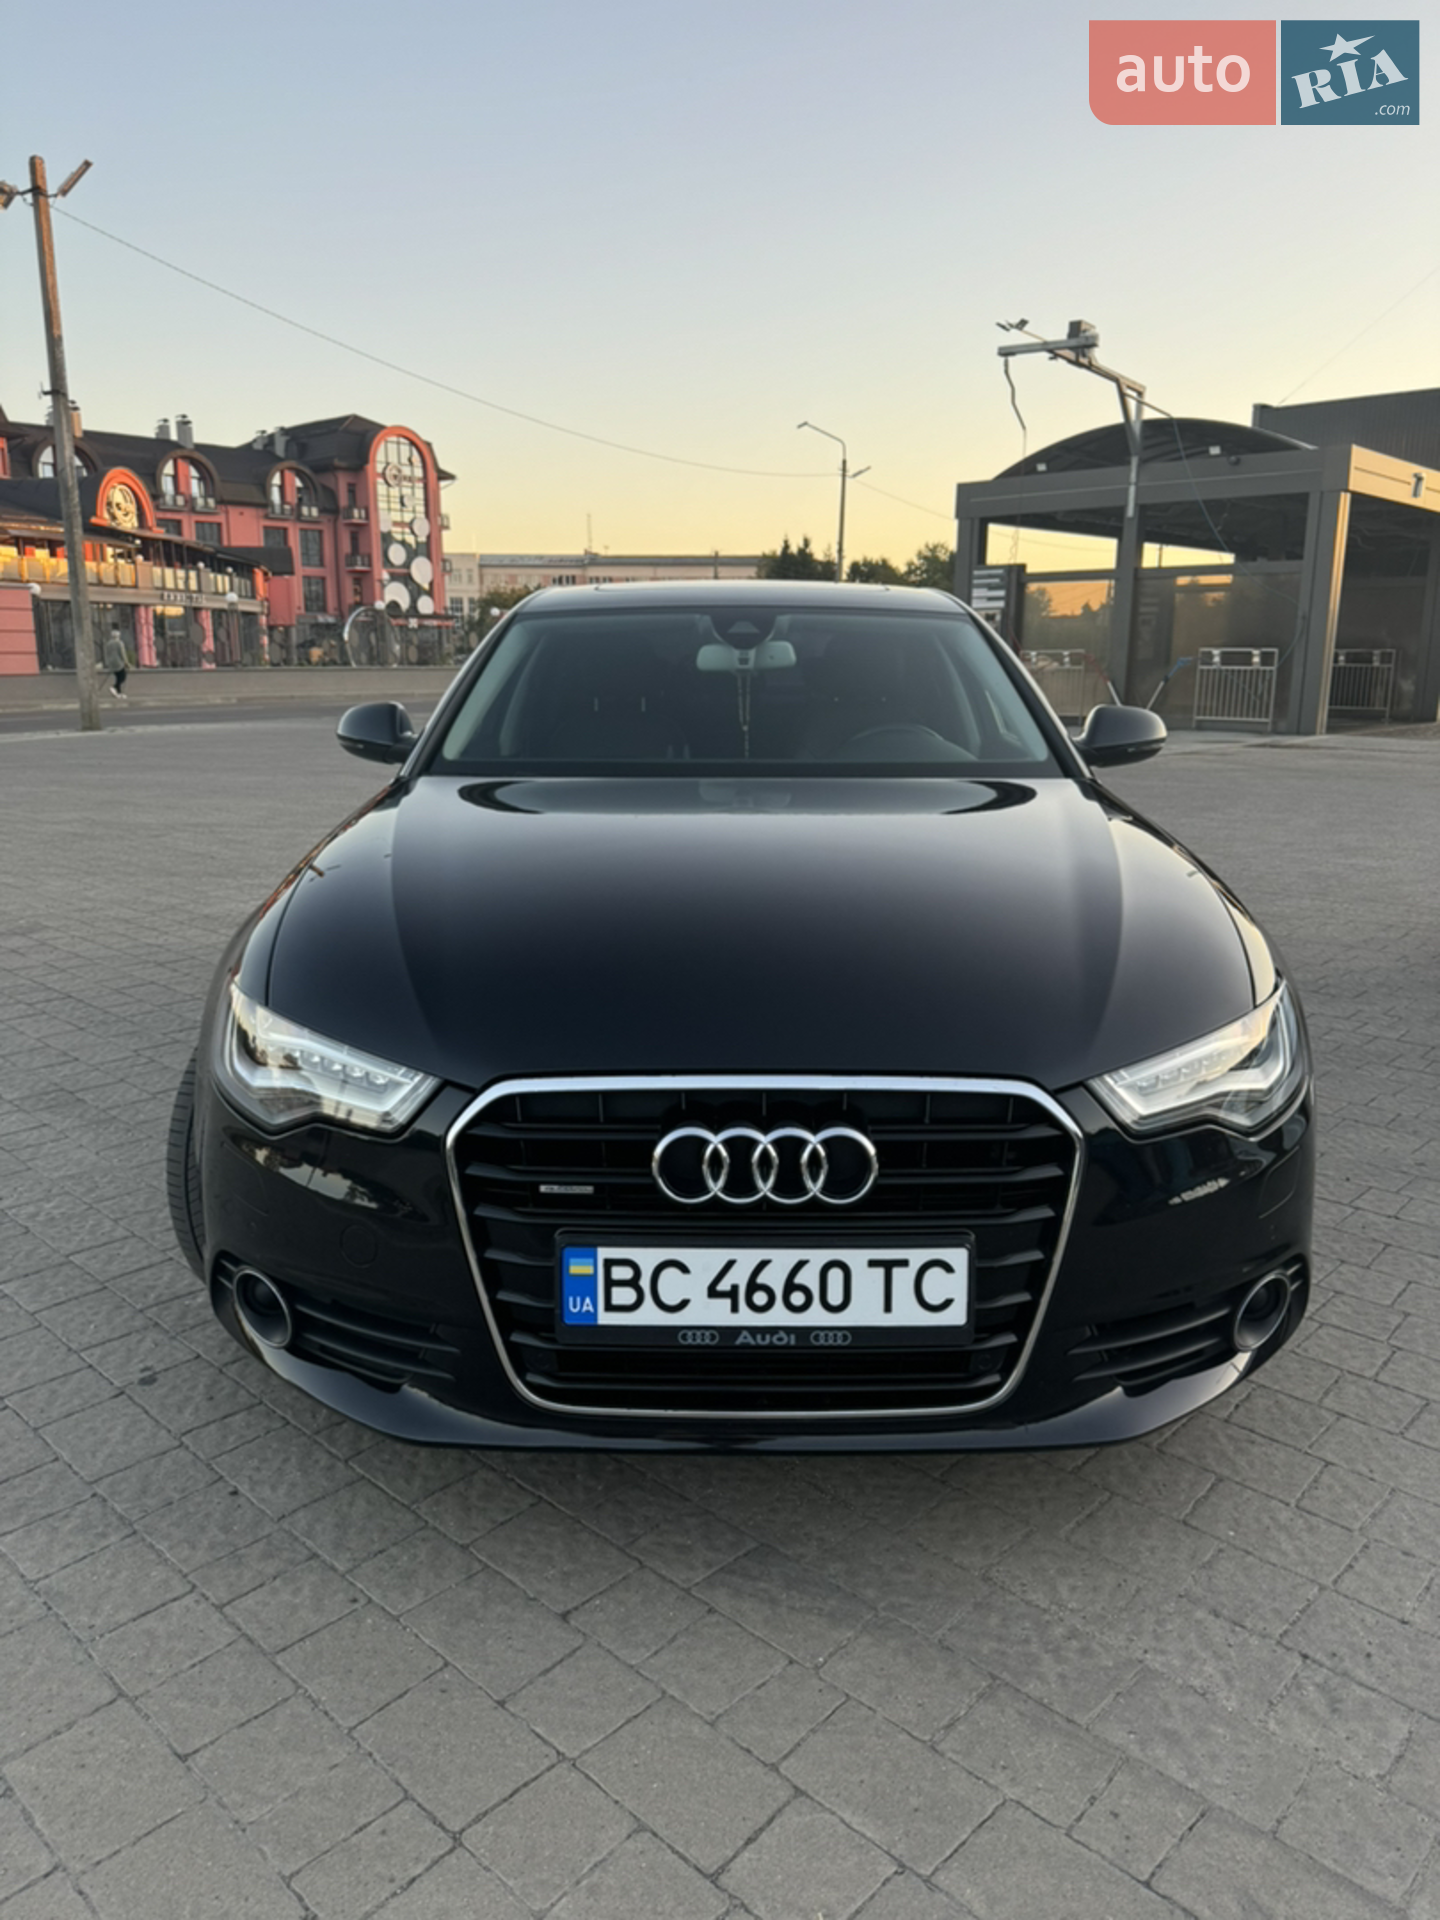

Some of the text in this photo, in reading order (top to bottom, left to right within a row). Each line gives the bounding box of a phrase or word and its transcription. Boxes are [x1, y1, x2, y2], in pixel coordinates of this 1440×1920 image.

[602, 1258, 956, 1315] BC 4660 TC
[568, 1296, 595, 1314] UA
[735, 1330, 796, 1346] Audi
